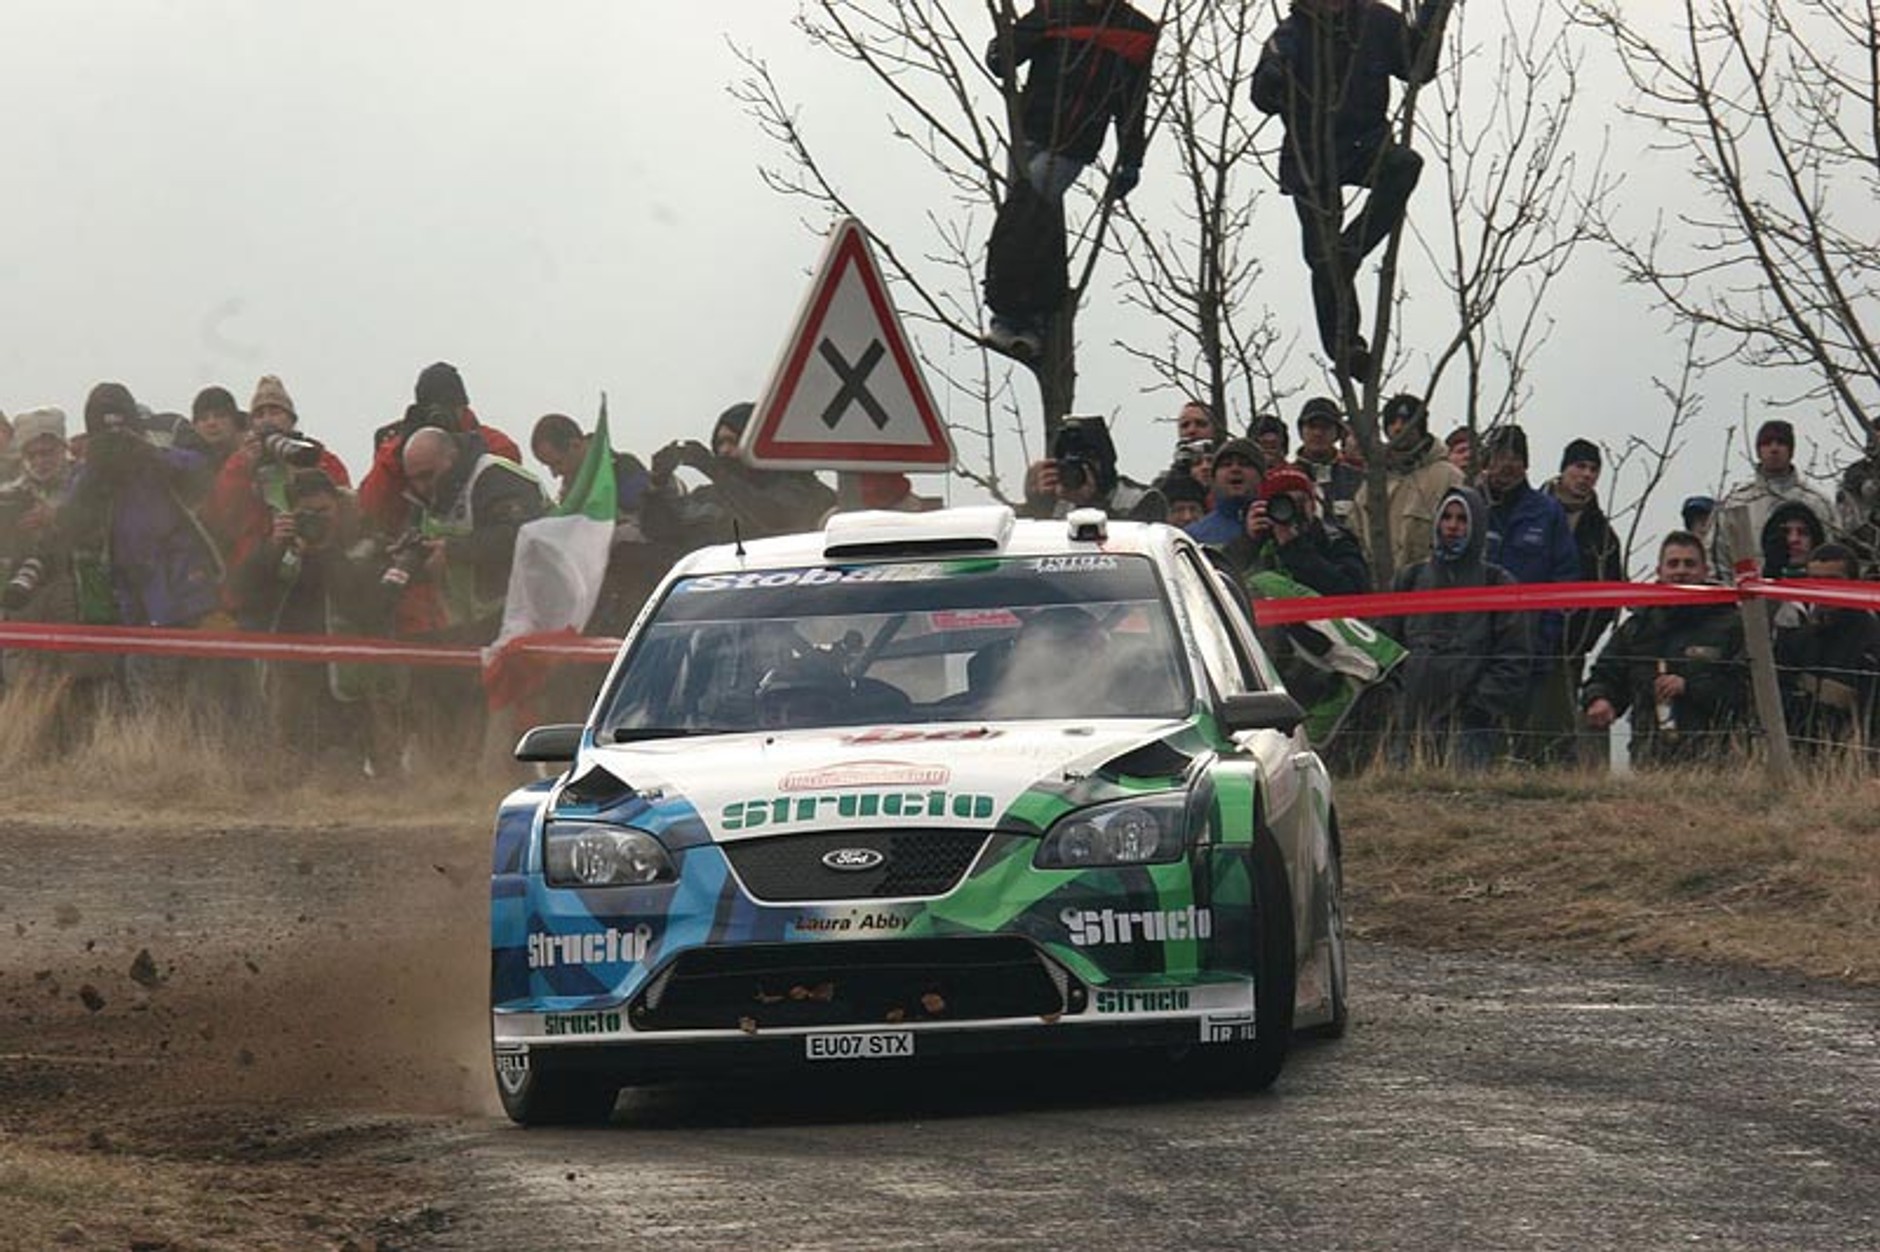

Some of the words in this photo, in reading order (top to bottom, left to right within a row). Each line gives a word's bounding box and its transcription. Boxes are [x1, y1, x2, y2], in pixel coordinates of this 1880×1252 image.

[795, 916, 852, 931] Laura
[859, 913, 912, 932] Abby
[812, 1036, 863, 1055] EU07
[868, 1034, 909, 1053] STX
